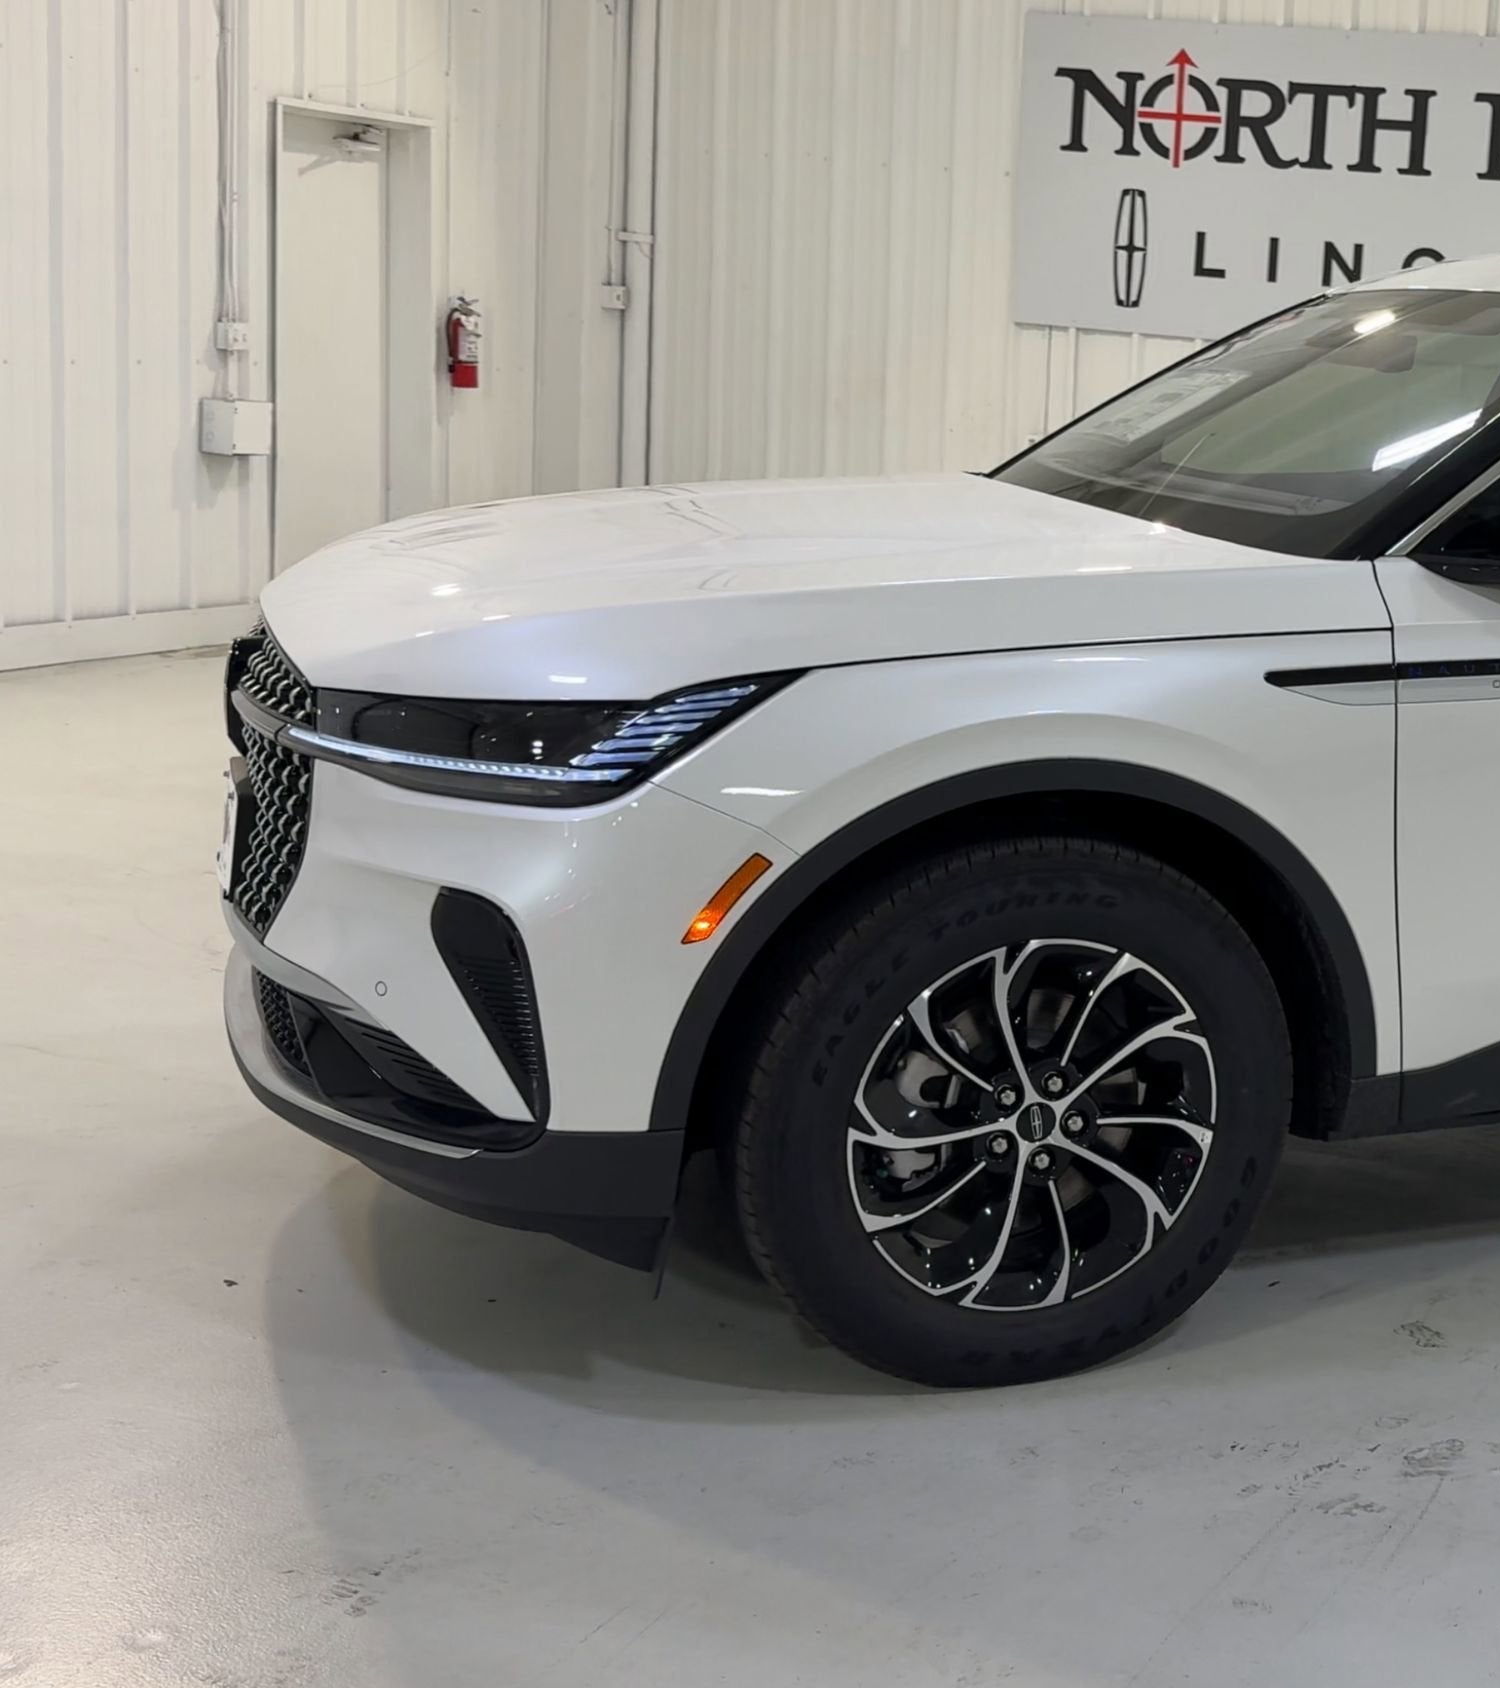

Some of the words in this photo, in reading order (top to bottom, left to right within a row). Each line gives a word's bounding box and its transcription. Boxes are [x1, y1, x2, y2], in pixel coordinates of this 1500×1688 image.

[1055, 65, 1437, 177] NORTH
[811, 946, 911, 1087] EAGLE
[927, 890, 1122, 943] TOURING
